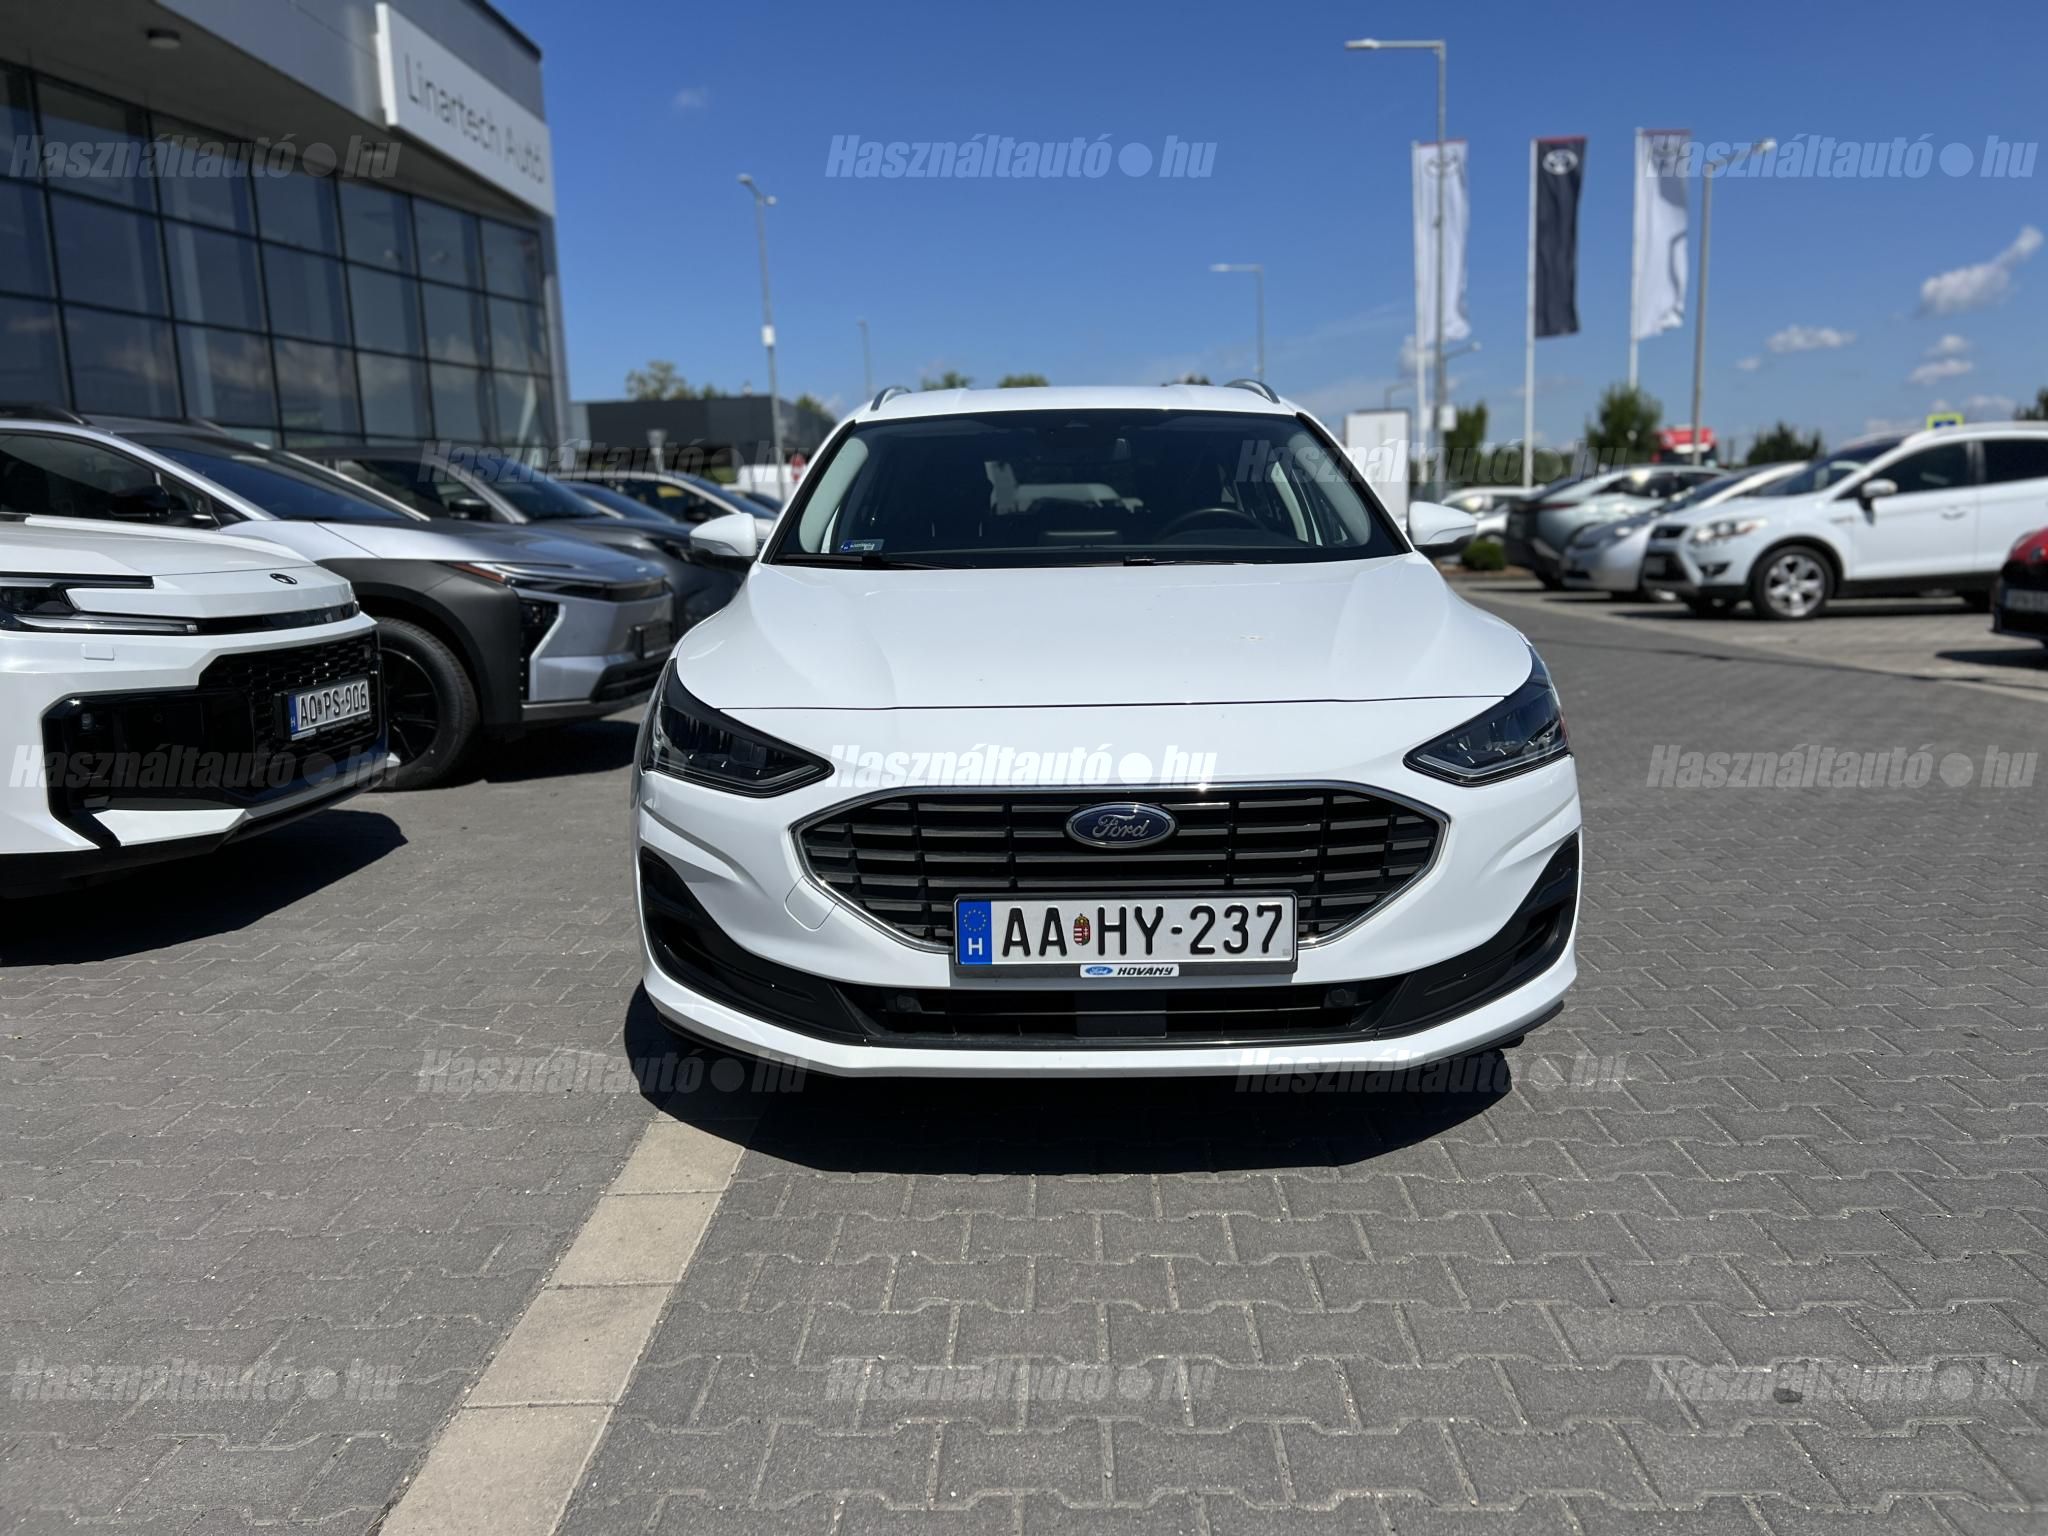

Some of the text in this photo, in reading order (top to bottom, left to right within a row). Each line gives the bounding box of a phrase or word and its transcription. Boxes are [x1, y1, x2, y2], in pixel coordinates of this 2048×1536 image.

[404, 53, 502, 157] Linartech
[1092, 814, 1150, 838] Ford
[968, 938, 983, 955] H
[1117, 967, 1174, 976] HOVANY
